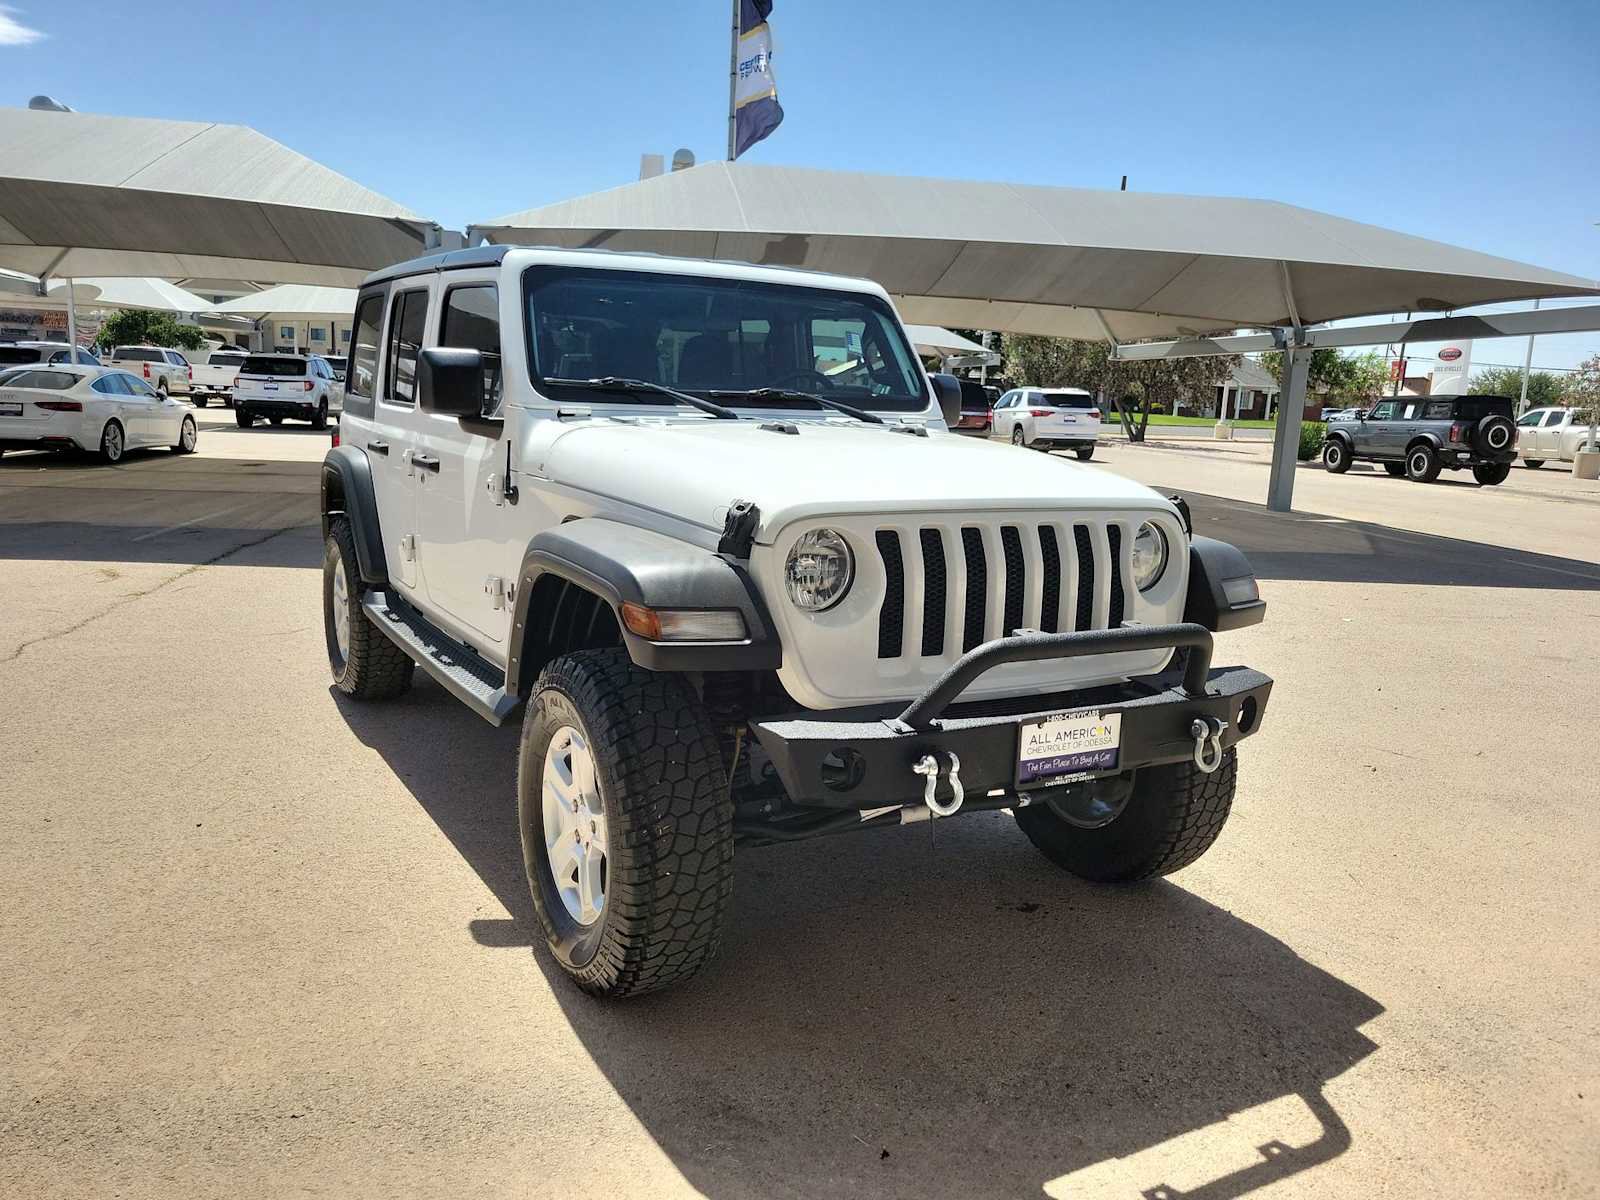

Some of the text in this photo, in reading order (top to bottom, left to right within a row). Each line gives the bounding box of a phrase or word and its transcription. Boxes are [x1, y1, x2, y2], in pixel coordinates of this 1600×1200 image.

[1029, 726, 1112, 745] ALL AMERICN
[1027, 742, 1071, 755] CHEVROLET
[1084, 737, 1113, 747] ODESSA
[1027, 752, 1111, 773] The Fun Place To Buy A Car
